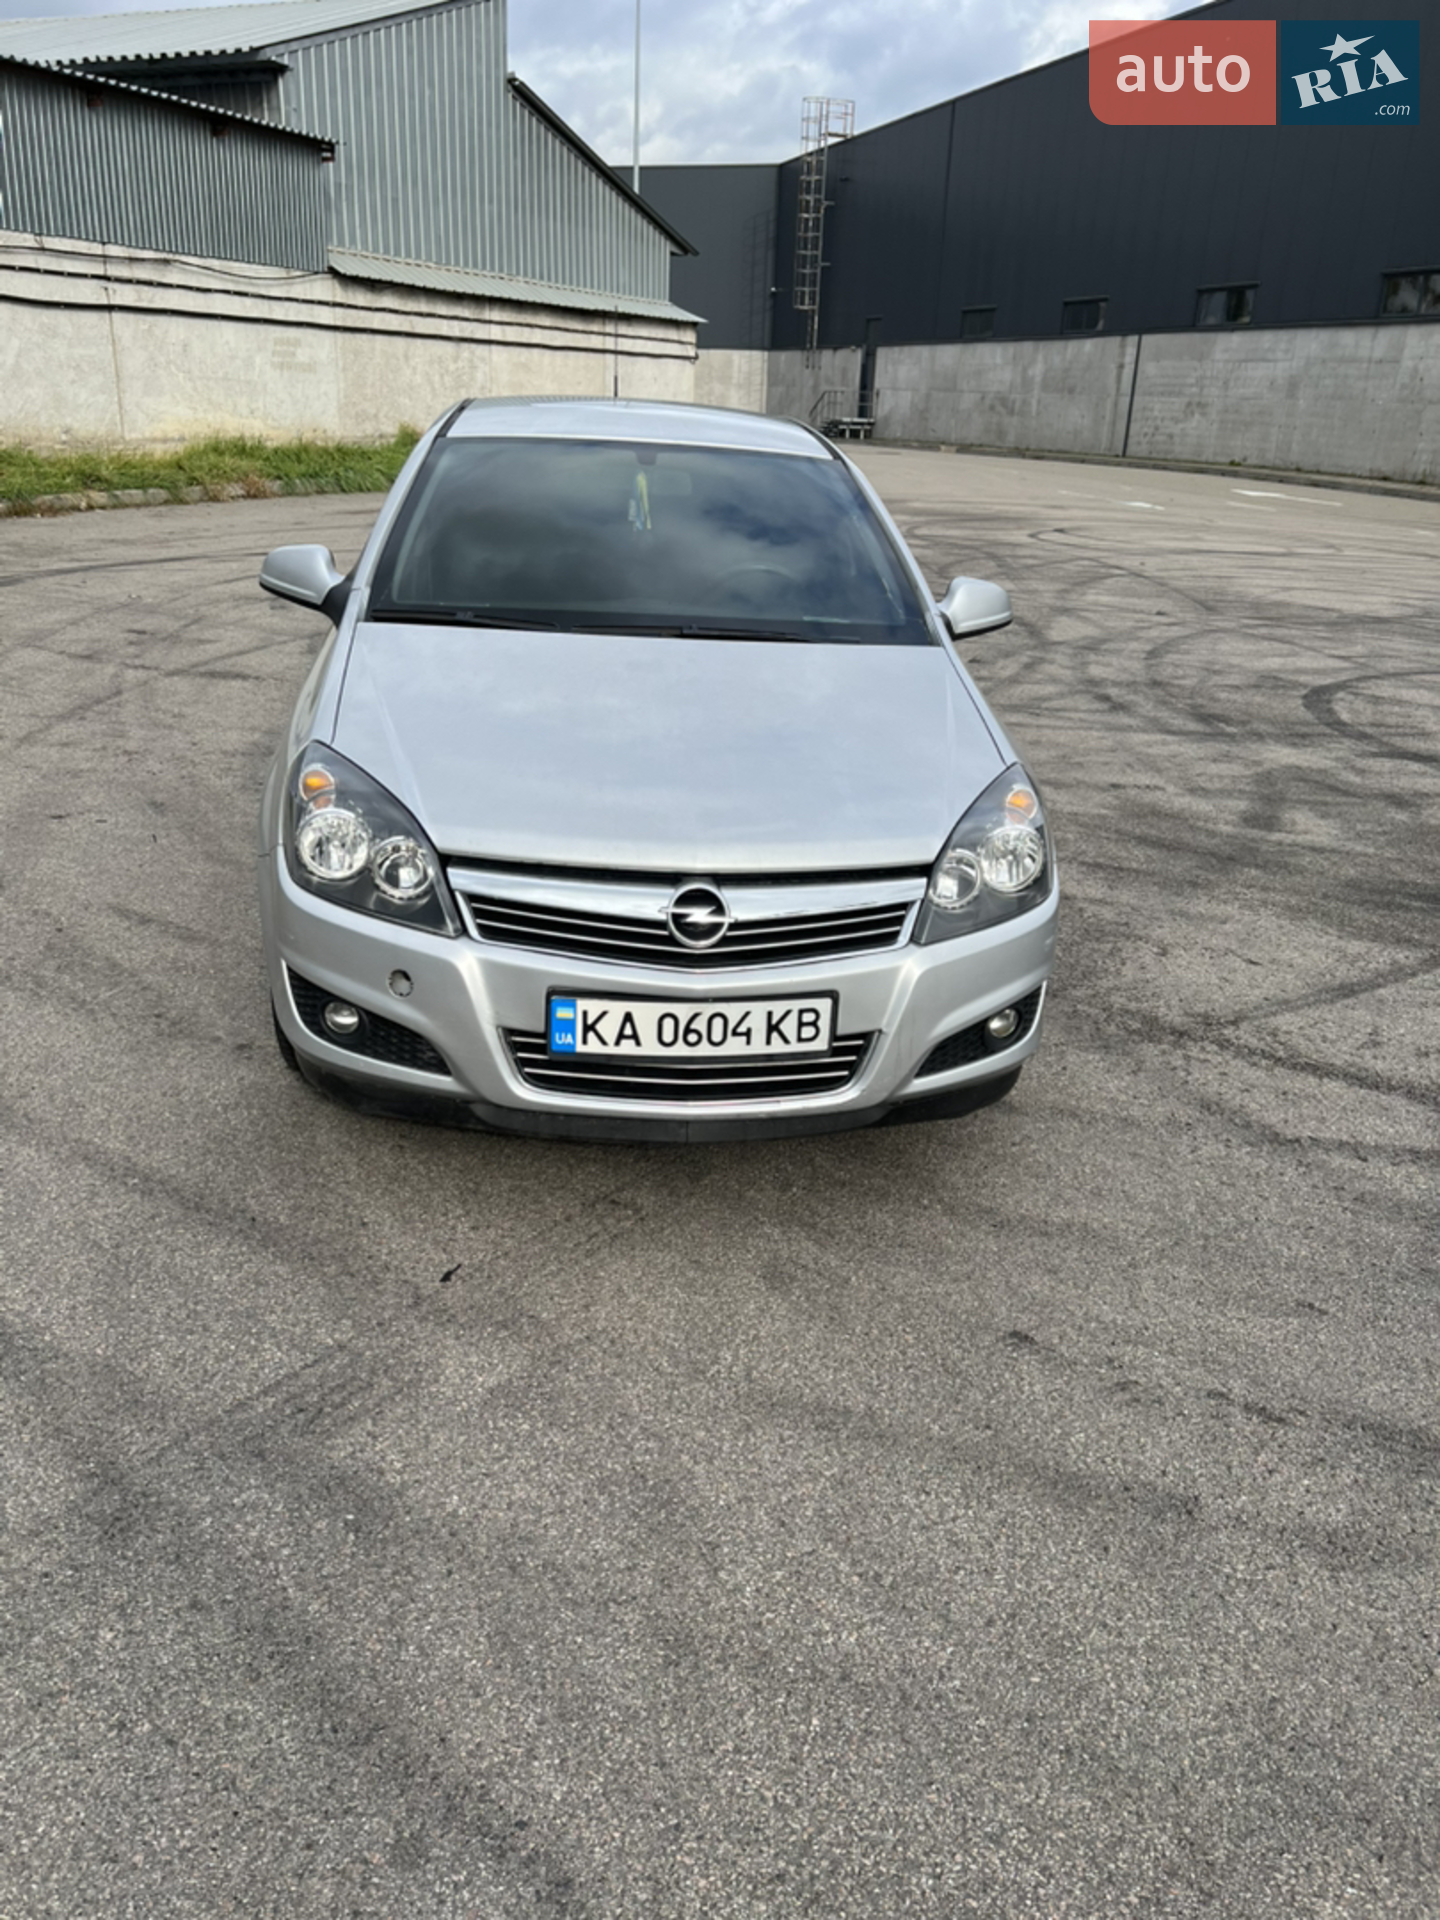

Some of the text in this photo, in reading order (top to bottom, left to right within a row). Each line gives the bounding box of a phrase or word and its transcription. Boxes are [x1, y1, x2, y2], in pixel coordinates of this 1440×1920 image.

[555, 1032, 574, 1045] UA
[581, 1007, 821, 1047] KA 0604 KB
